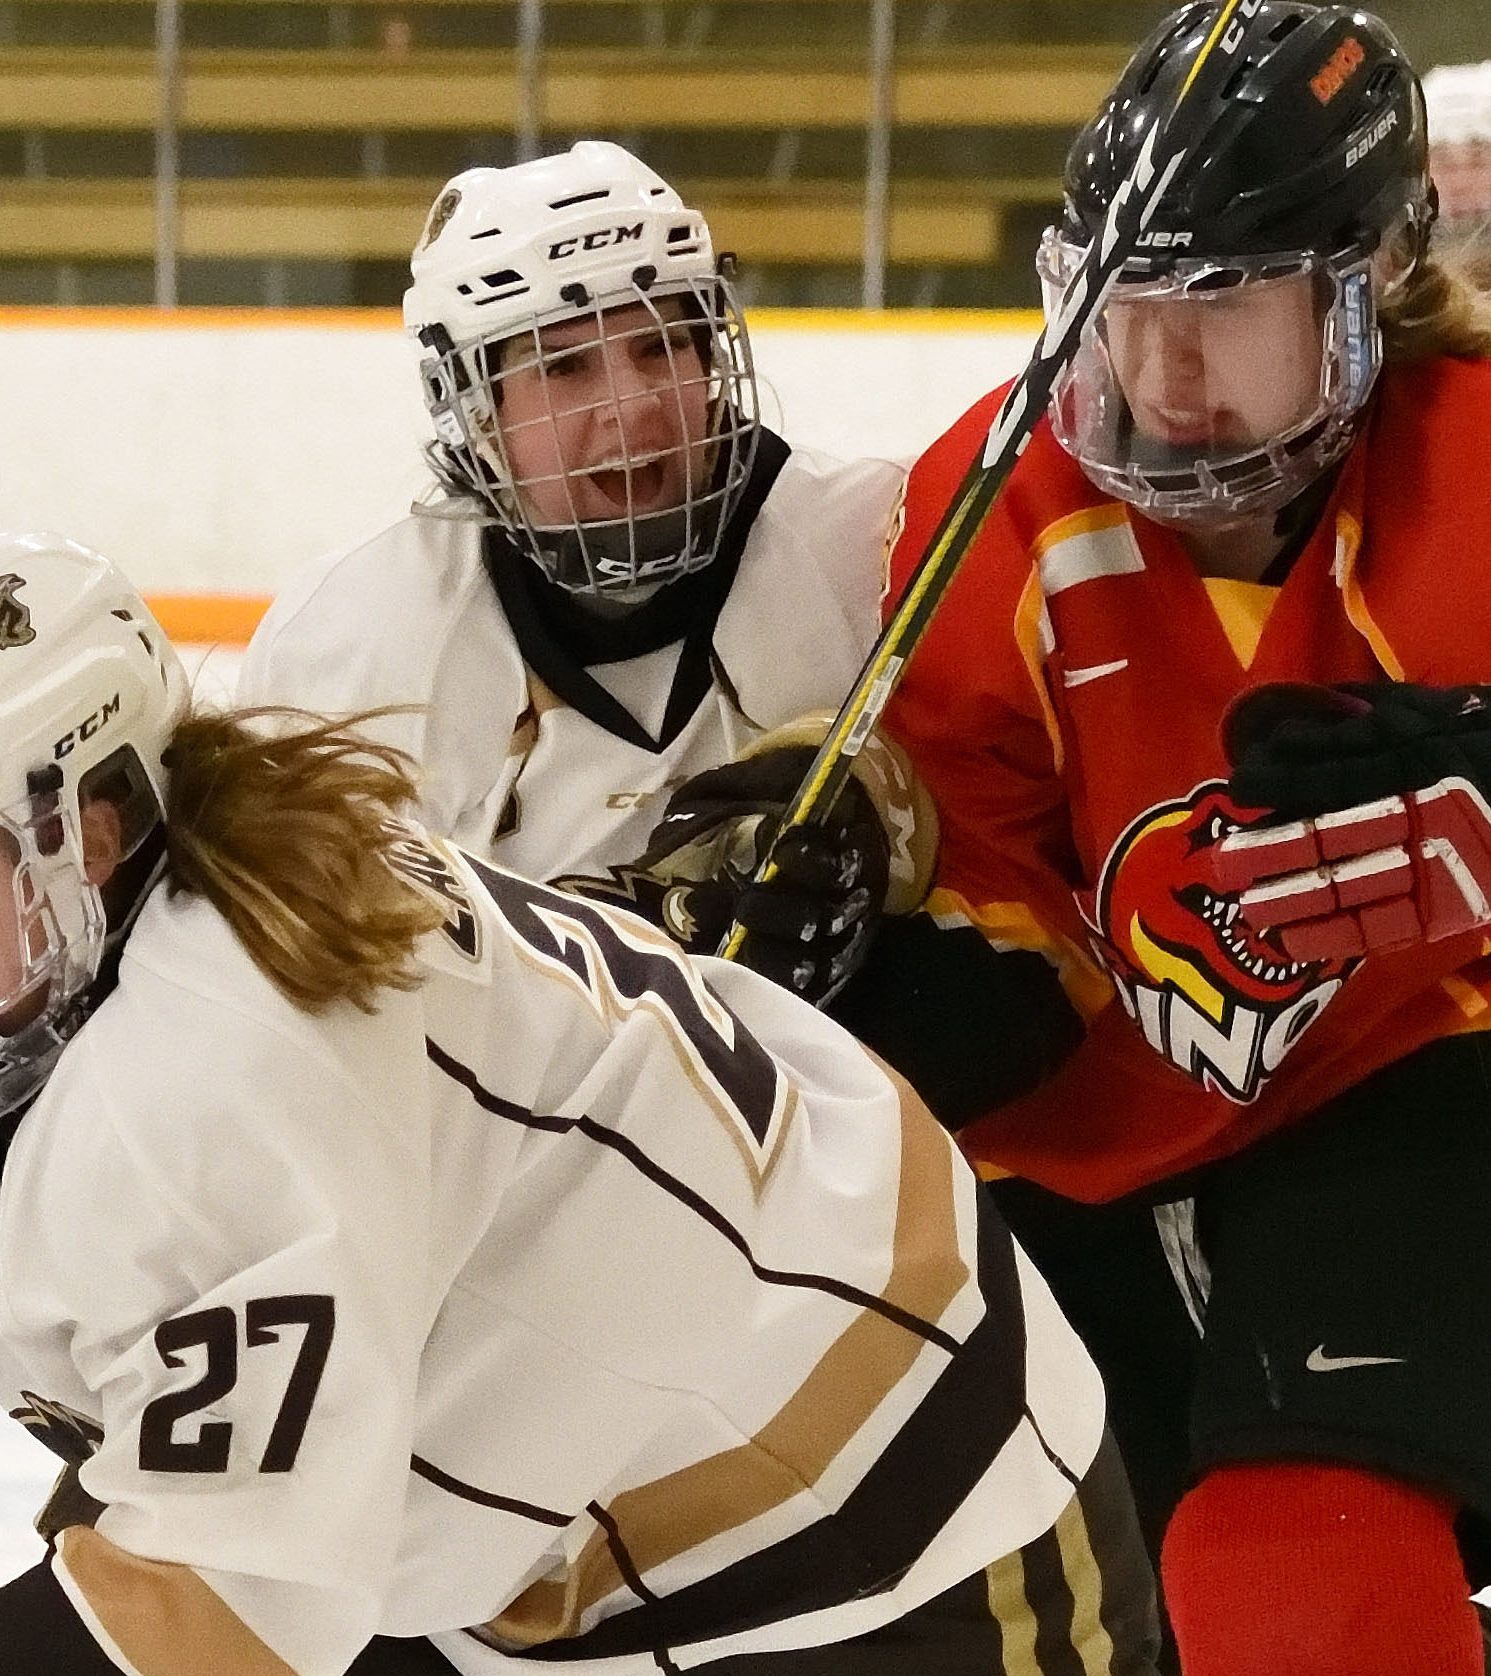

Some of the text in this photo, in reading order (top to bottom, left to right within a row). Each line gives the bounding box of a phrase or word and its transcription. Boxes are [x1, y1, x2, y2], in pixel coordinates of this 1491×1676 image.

[547, 222, 646, 260] CCM
[54, 693, 122, 760] CCM
[138, 1293, 336, 1474] 27
